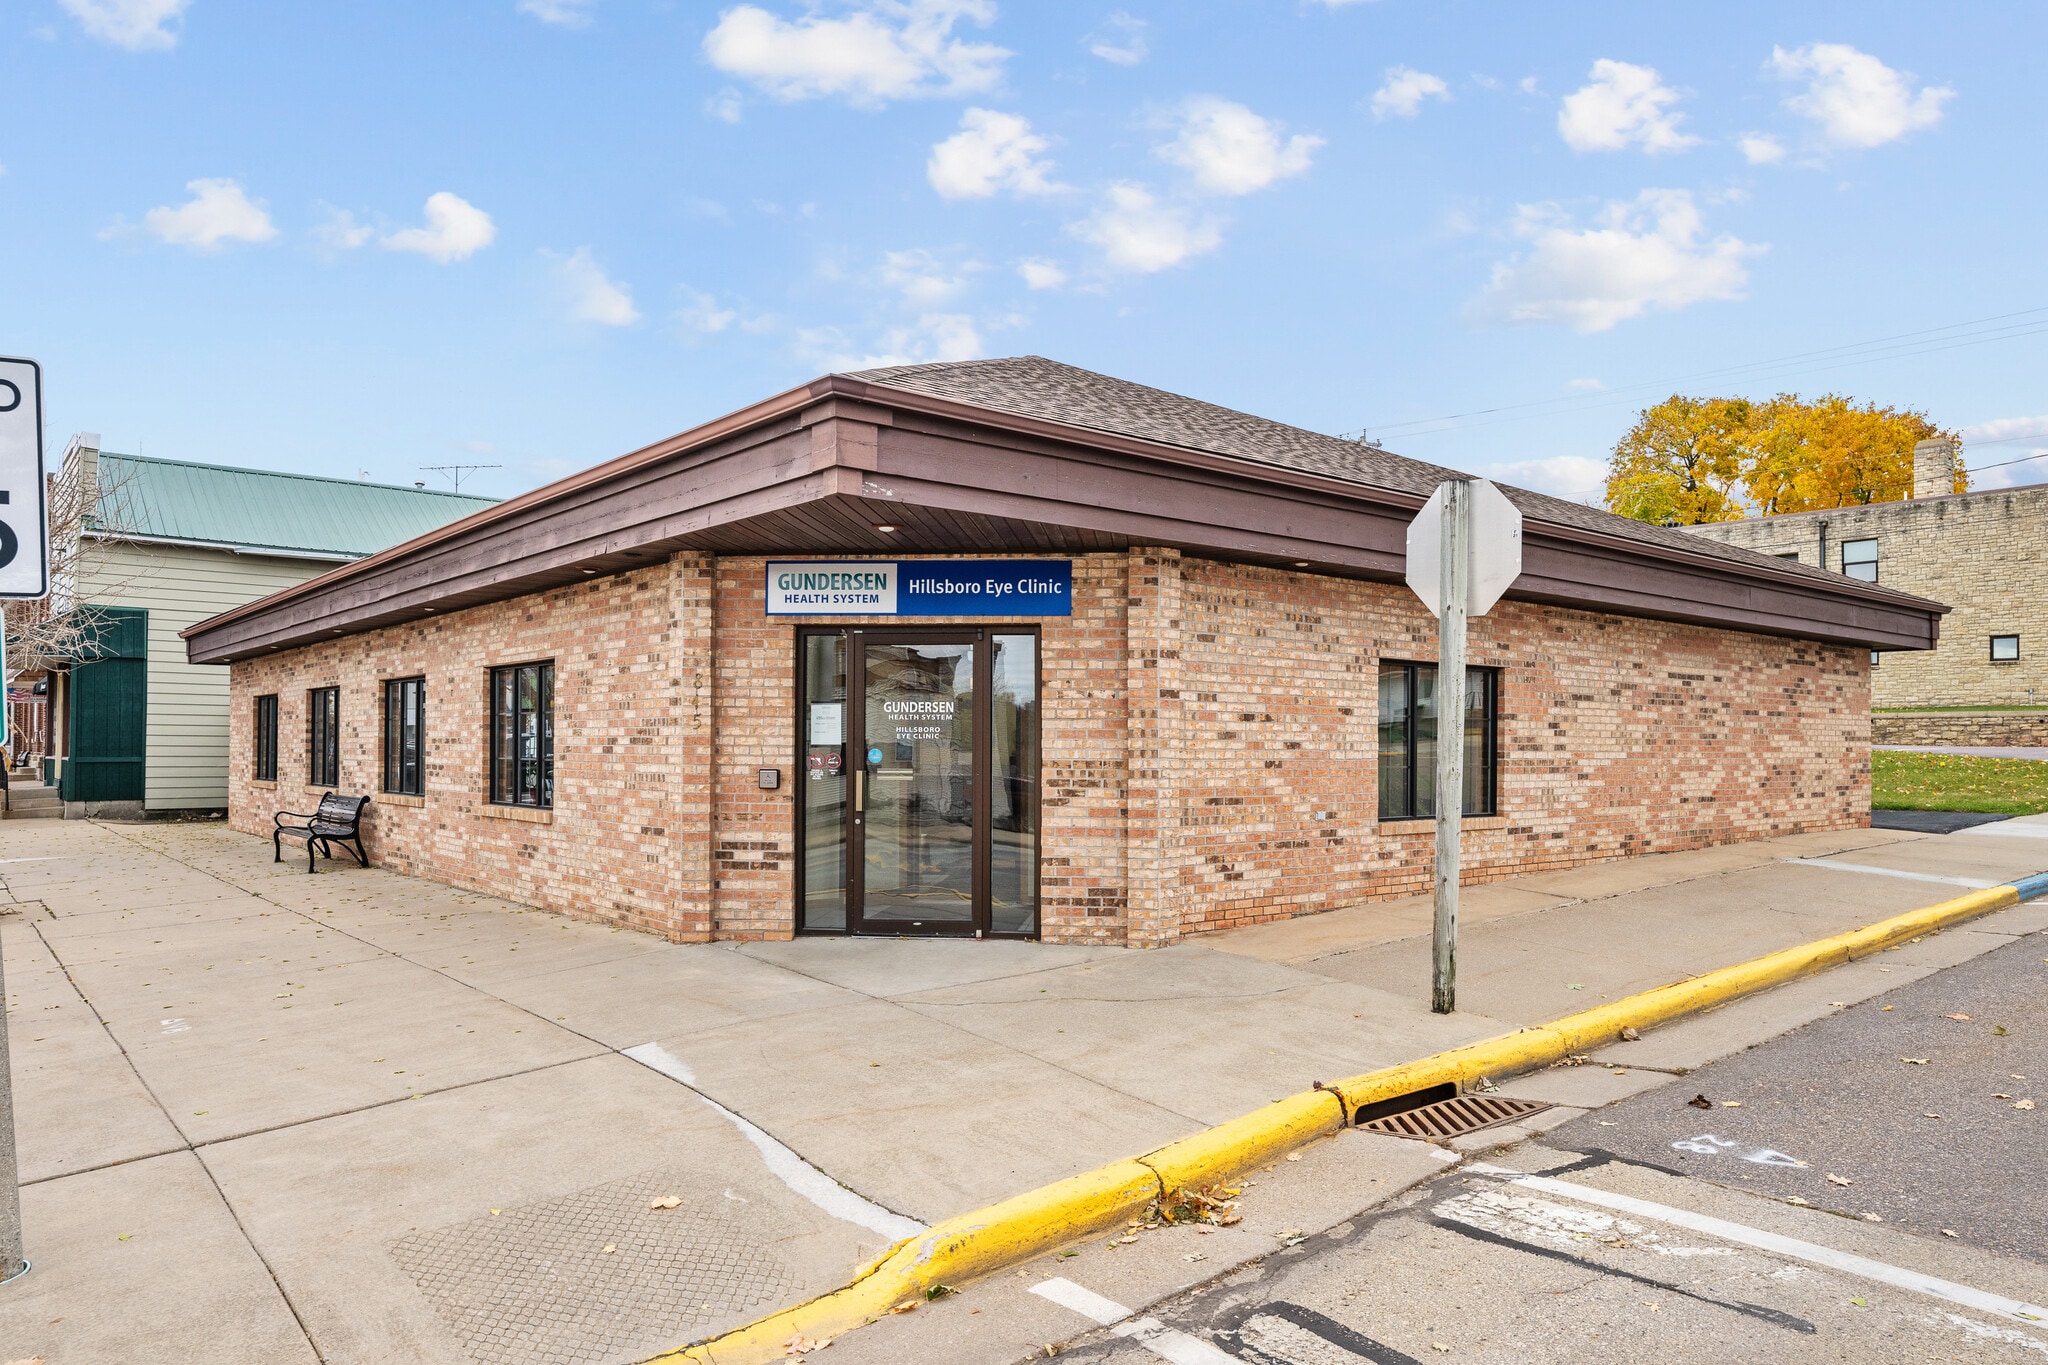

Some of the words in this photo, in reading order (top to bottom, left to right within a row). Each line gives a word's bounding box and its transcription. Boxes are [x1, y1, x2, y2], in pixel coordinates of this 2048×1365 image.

[777, 572, 887, 591] GUNDERSEN
[909, 578, 981, 595] Hillsboro
[986, 579, 1013, 597] Eye
[1017, 578, 1062, 595] Clinic
[784, 594, 829, 604] HEALTH
[833, 594, 880, 604] SYSTEM
[883, 701, 955, 713] GUNDERSEN
